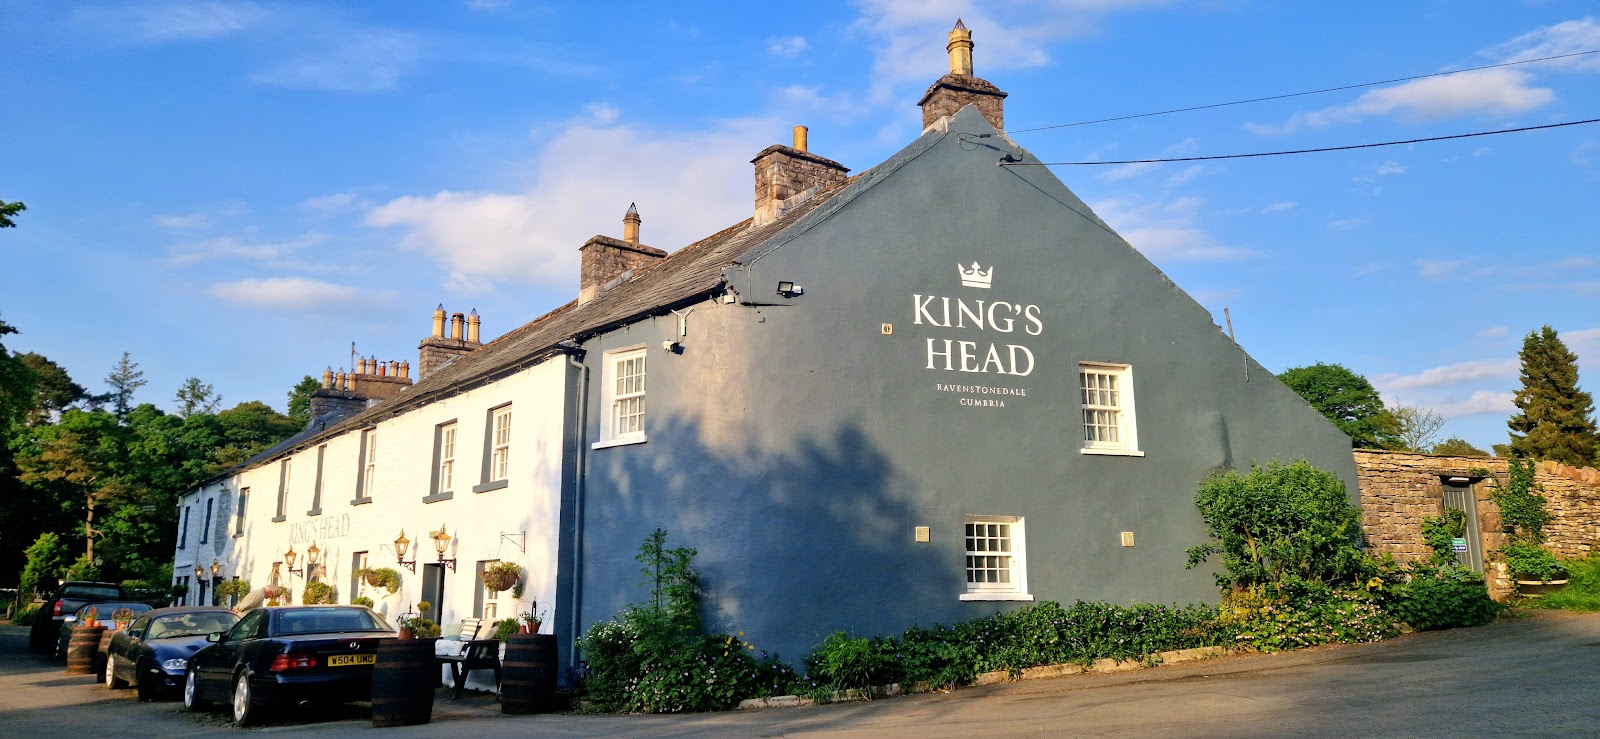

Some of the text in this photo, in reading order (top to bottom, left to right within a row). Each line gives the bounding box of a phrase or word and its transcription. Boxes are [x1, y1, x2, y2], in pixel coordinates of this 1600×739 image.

[913, 294, 1043, 336] KING'S
[926, 338, 1035, 377] HEAD
[937, 383, 1026, 397] RAVENSTONEDALE
[960, 398, 1005, 408] CUMBRIA
[319, 513, 350, 540] HEAD
[332, 655, 354, 665] W504
